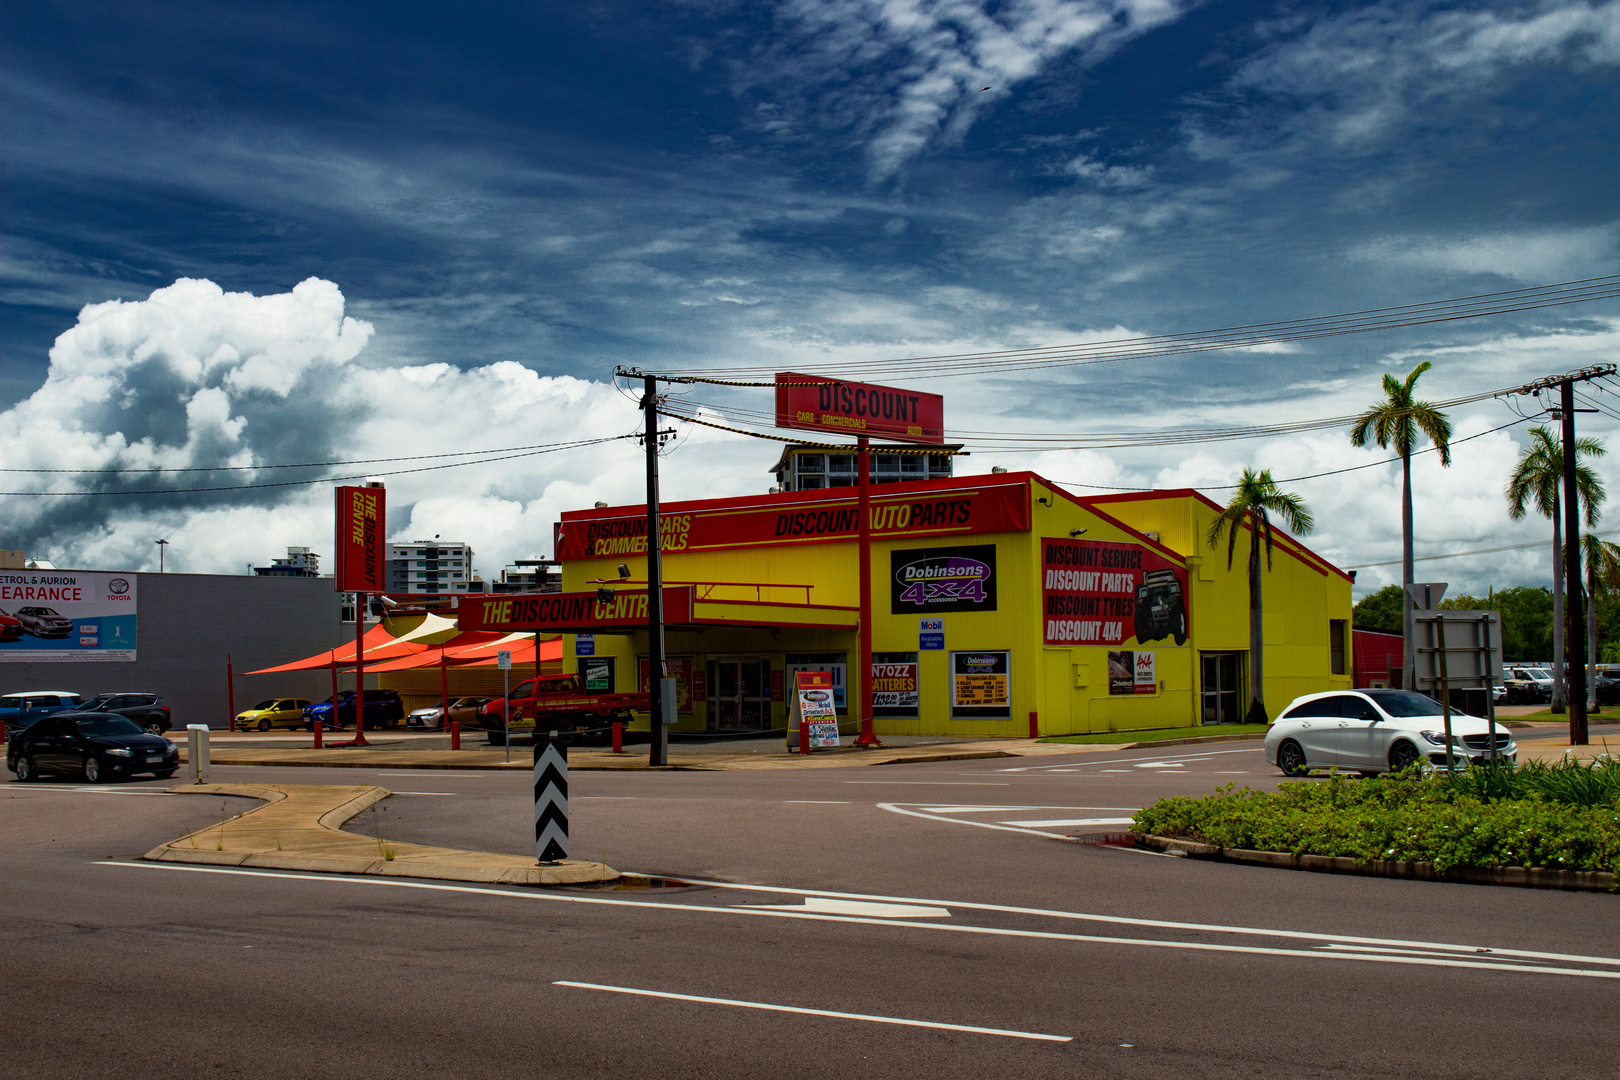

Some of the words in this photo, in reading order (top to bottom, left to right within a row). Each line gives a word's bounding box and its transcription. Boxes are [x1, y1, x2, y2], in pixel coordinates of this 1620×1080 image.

[819, 385, 920, 423] DISCOUNT
[797, 411, 815, 423] CARS
[822, 414, 867, 429] COMMERCIALS
[353, 491, 365, 547] CENTRE
[588, 520, 647, 540] DISCOUN
[1045, 545, 1100, 567] DISCOUNT
[1101, 549, 1143, 569] SERVICE
[40, 577, 76, 585] AURION
[905, 565, 984, 578] Dobinsons
[1045, 569, 1101, 592] DISCOUNT
[1101, 572, 1134, 593] PARTS
[0, 586, 82, 601] EARANCE
[1047, 595, 1101, 616] DISCOUNT
[1103, 597, 1133, 617] TYRES
[921, 621, 942, 629] Mobil
[1046, 620, 1102, 641] DISCOUNT
[1102, 621, 1122, 641] 4X4
[872, 678, 915, 691] ATTERIES
